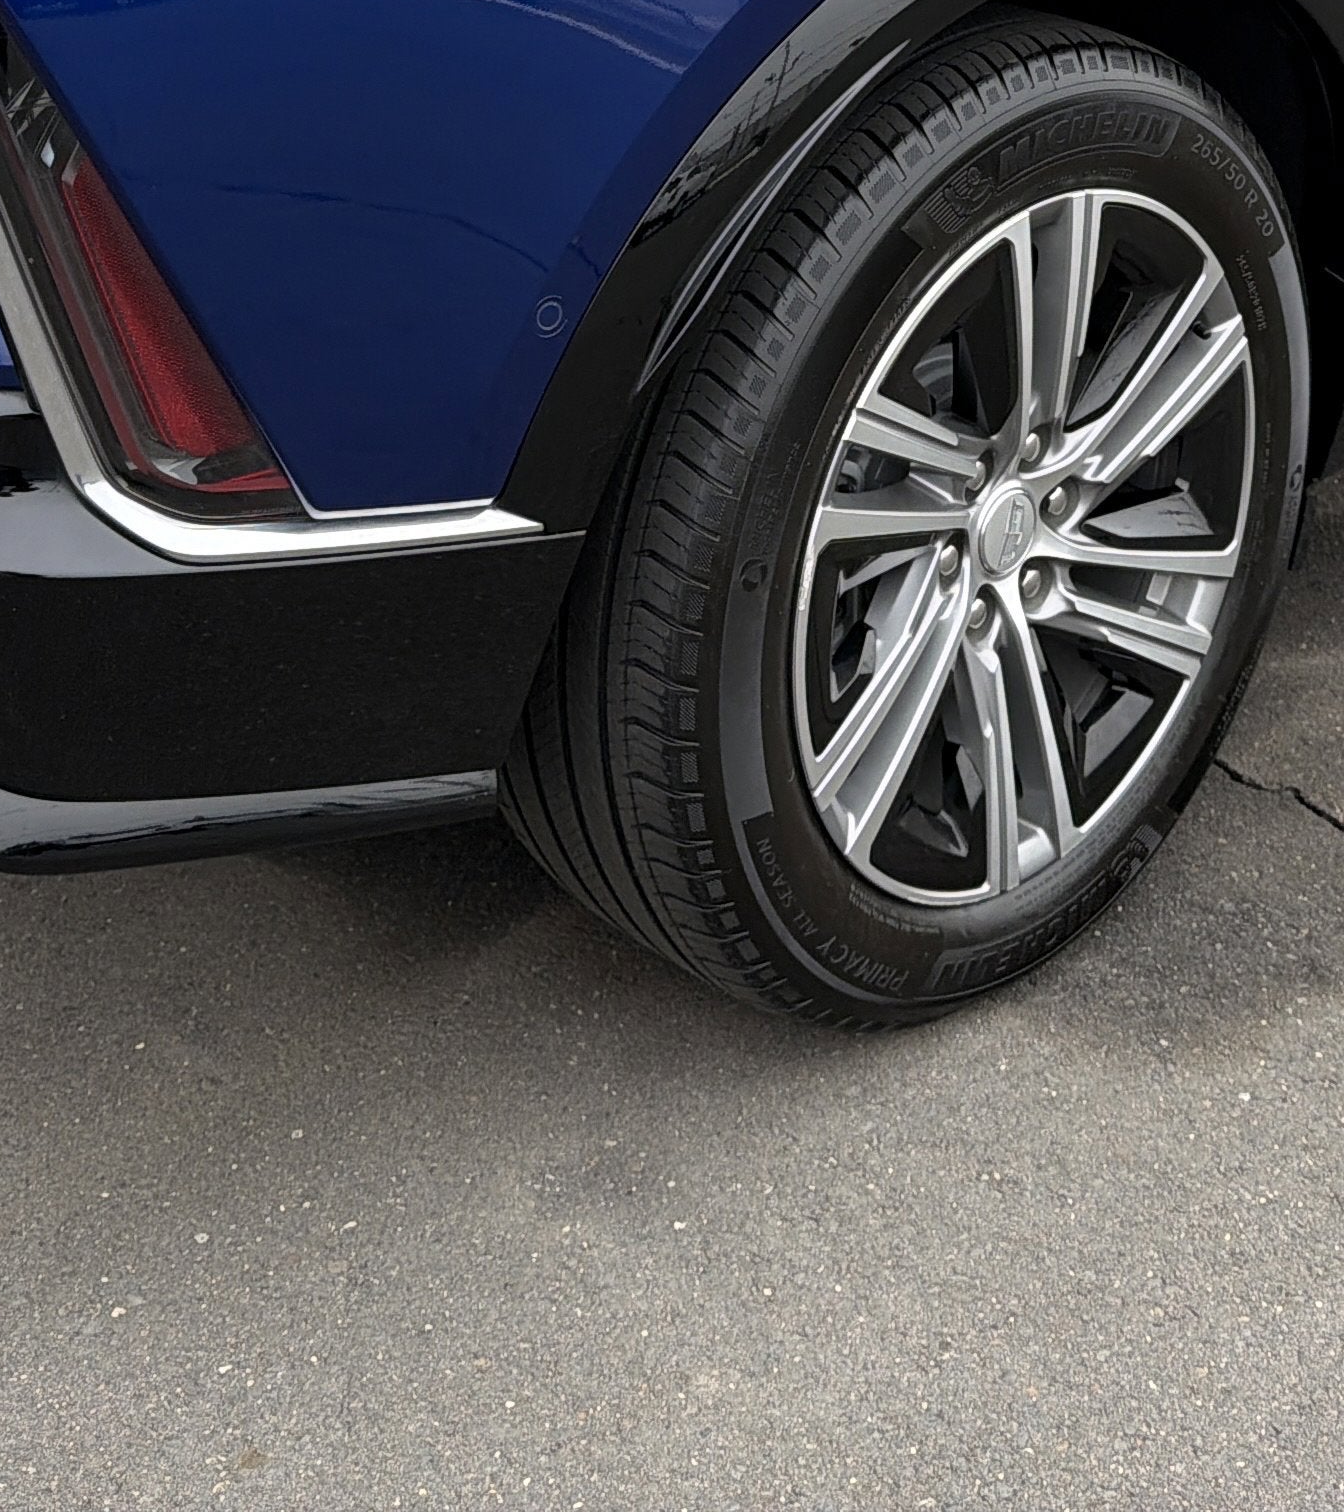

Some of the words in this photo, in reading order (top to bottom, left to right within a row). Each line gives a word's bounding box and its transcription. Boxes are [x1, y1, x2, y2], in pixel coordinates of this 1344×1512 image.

[997, 109, 1174, 184] MICHELIN
[1191, 133, 1247, 192] 265/50
[1243, 190, 1258, 208] R
[1255, 210, 1275, 239] 20
[756, 837, 794, 909] SEASON
[792, 909, 820, 937] ALL
[816, 935, 910, 992] PRIMACY
